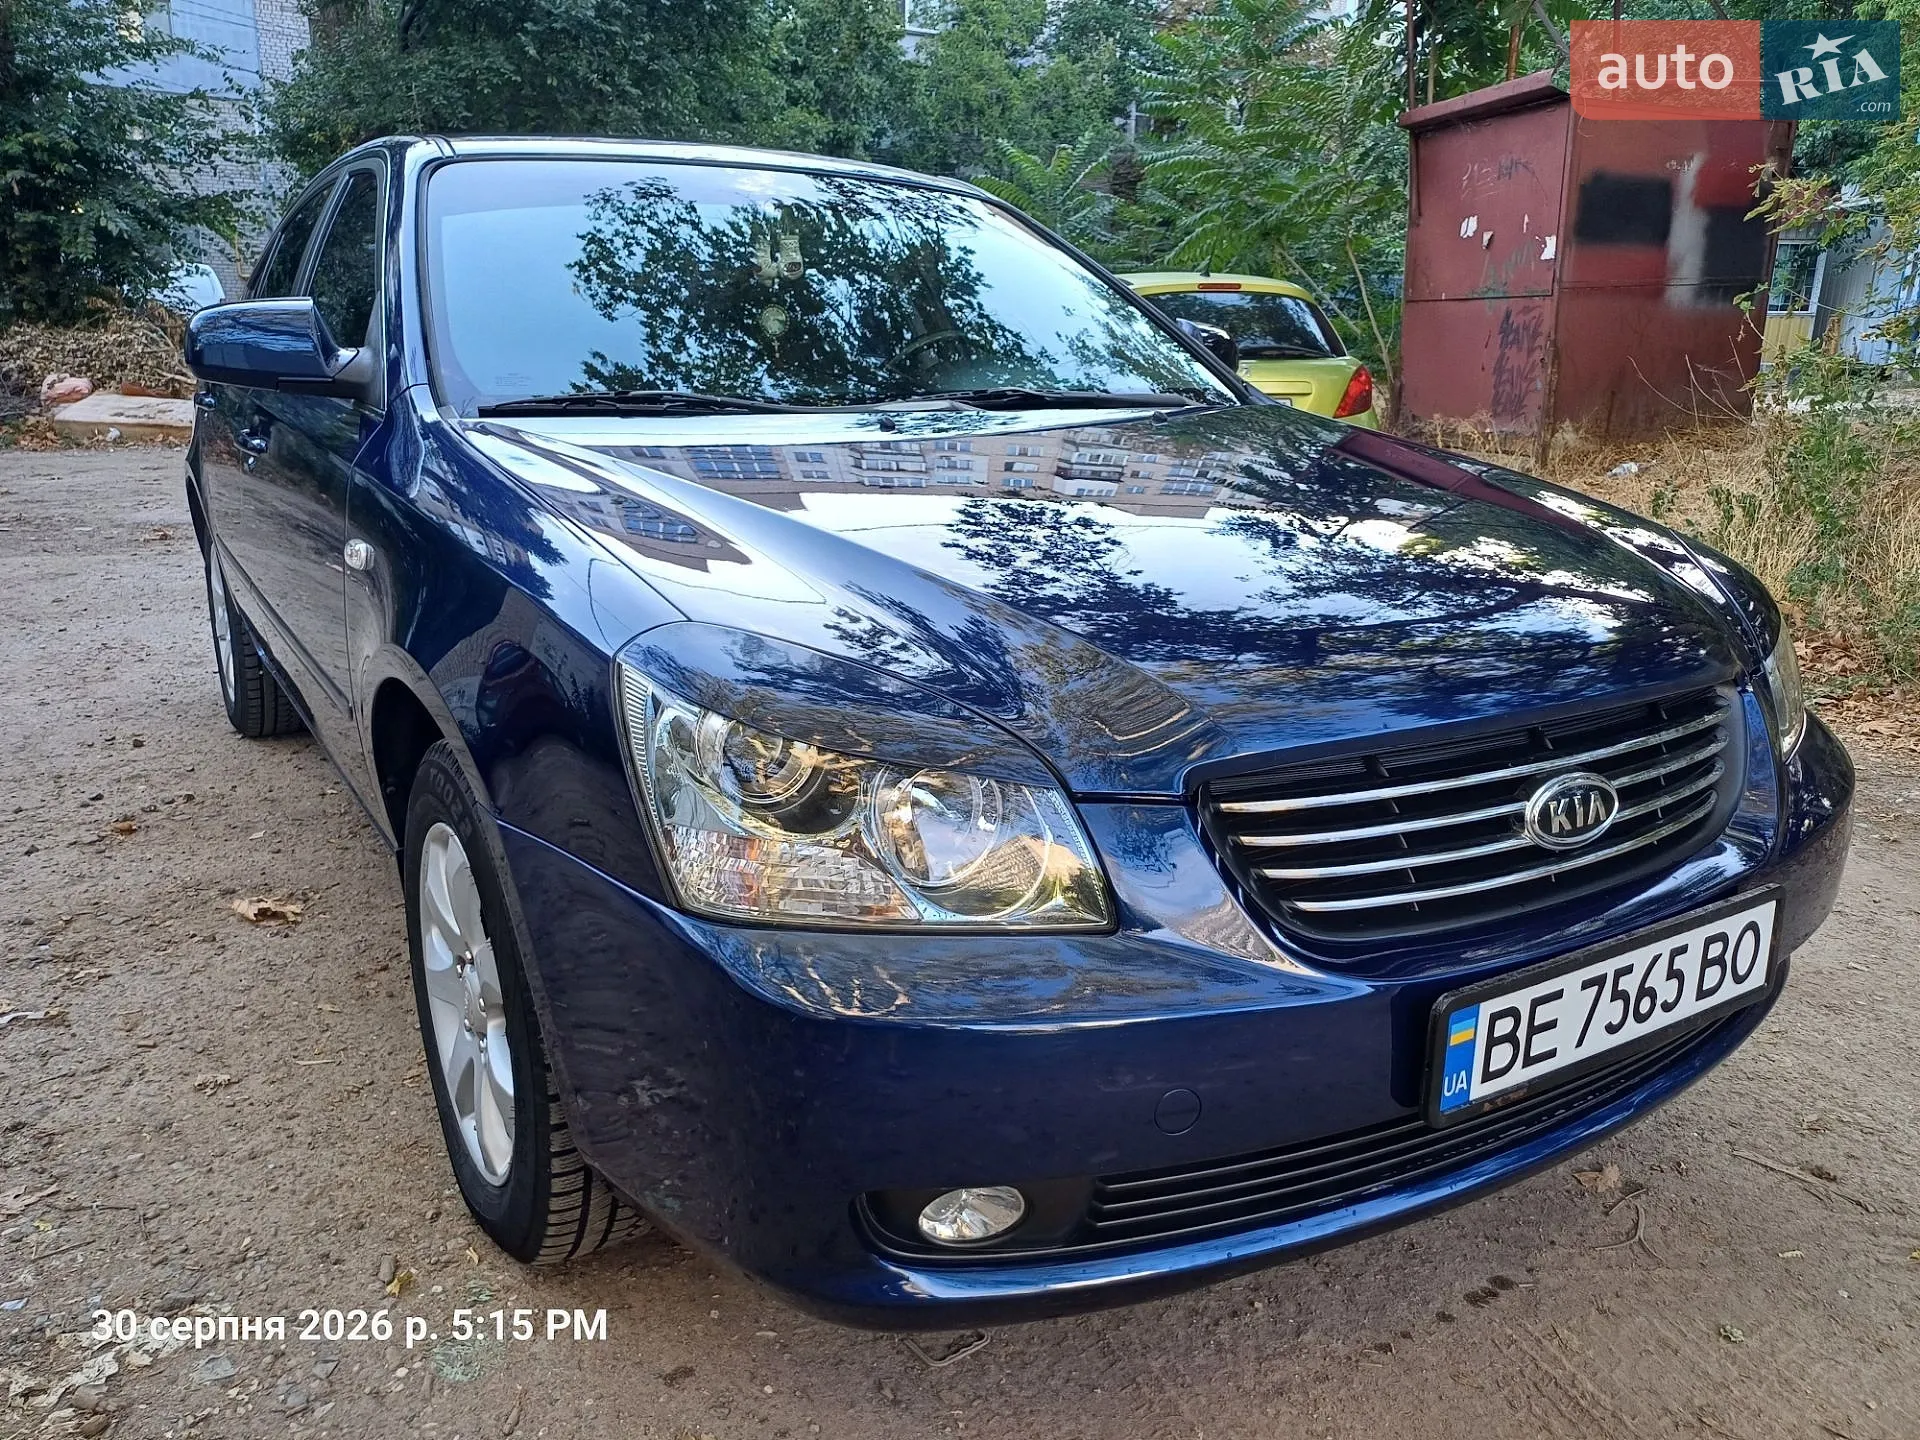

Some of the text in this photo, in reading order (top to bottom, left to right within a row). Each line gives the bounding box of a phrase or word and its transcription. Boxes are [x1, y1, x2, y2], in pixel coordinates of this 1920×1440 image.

[1548, 791, 1607, 833] KIA
[1480, 920, 1761, 1084] BE 7565 BO
[1443, 1070, 1468, 1097] UA
